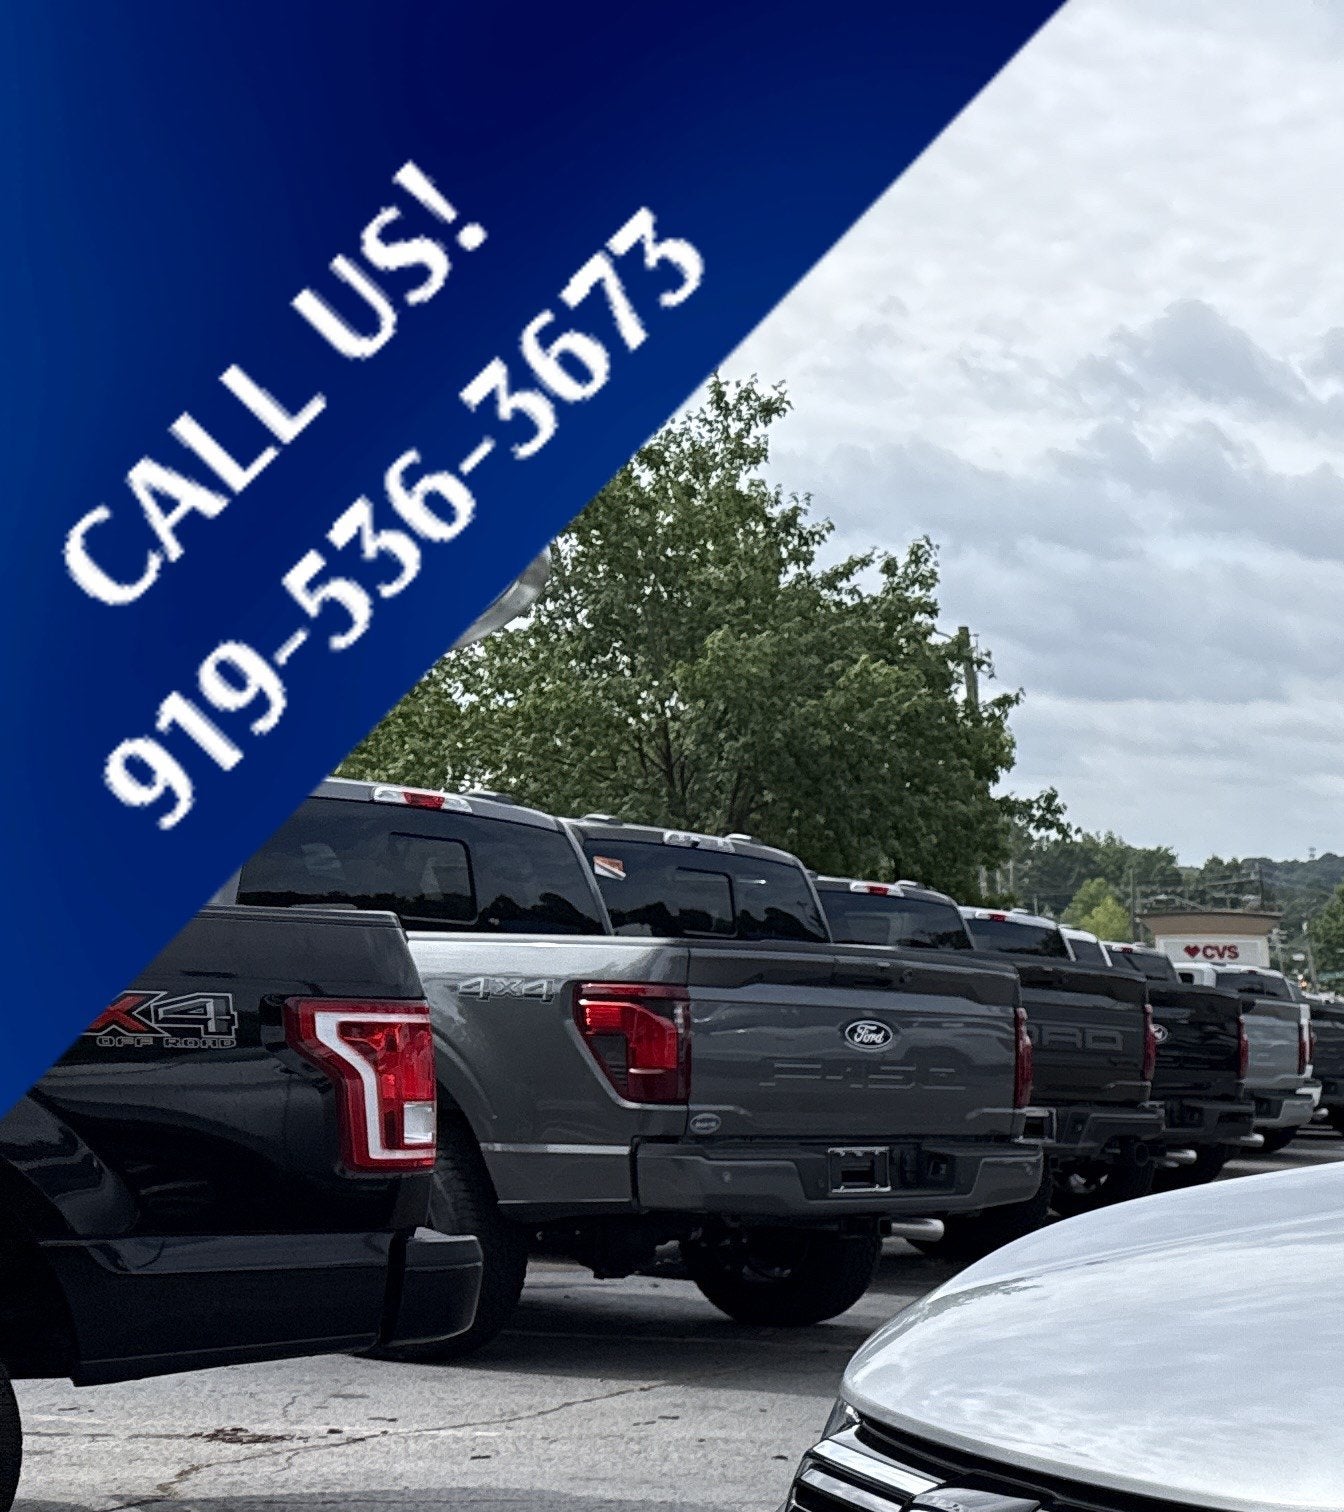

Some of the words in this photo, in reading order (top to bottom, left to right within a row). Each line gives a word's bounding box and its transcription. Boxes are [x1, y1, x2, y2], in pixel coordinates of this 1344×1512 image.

[1202, 944, 1239, 960] CVS
[854, 1023, 885, 1044] Ford
[96, 1036, 154, 1048] OFF
[162, 1036, 238, 1049] ROAD
